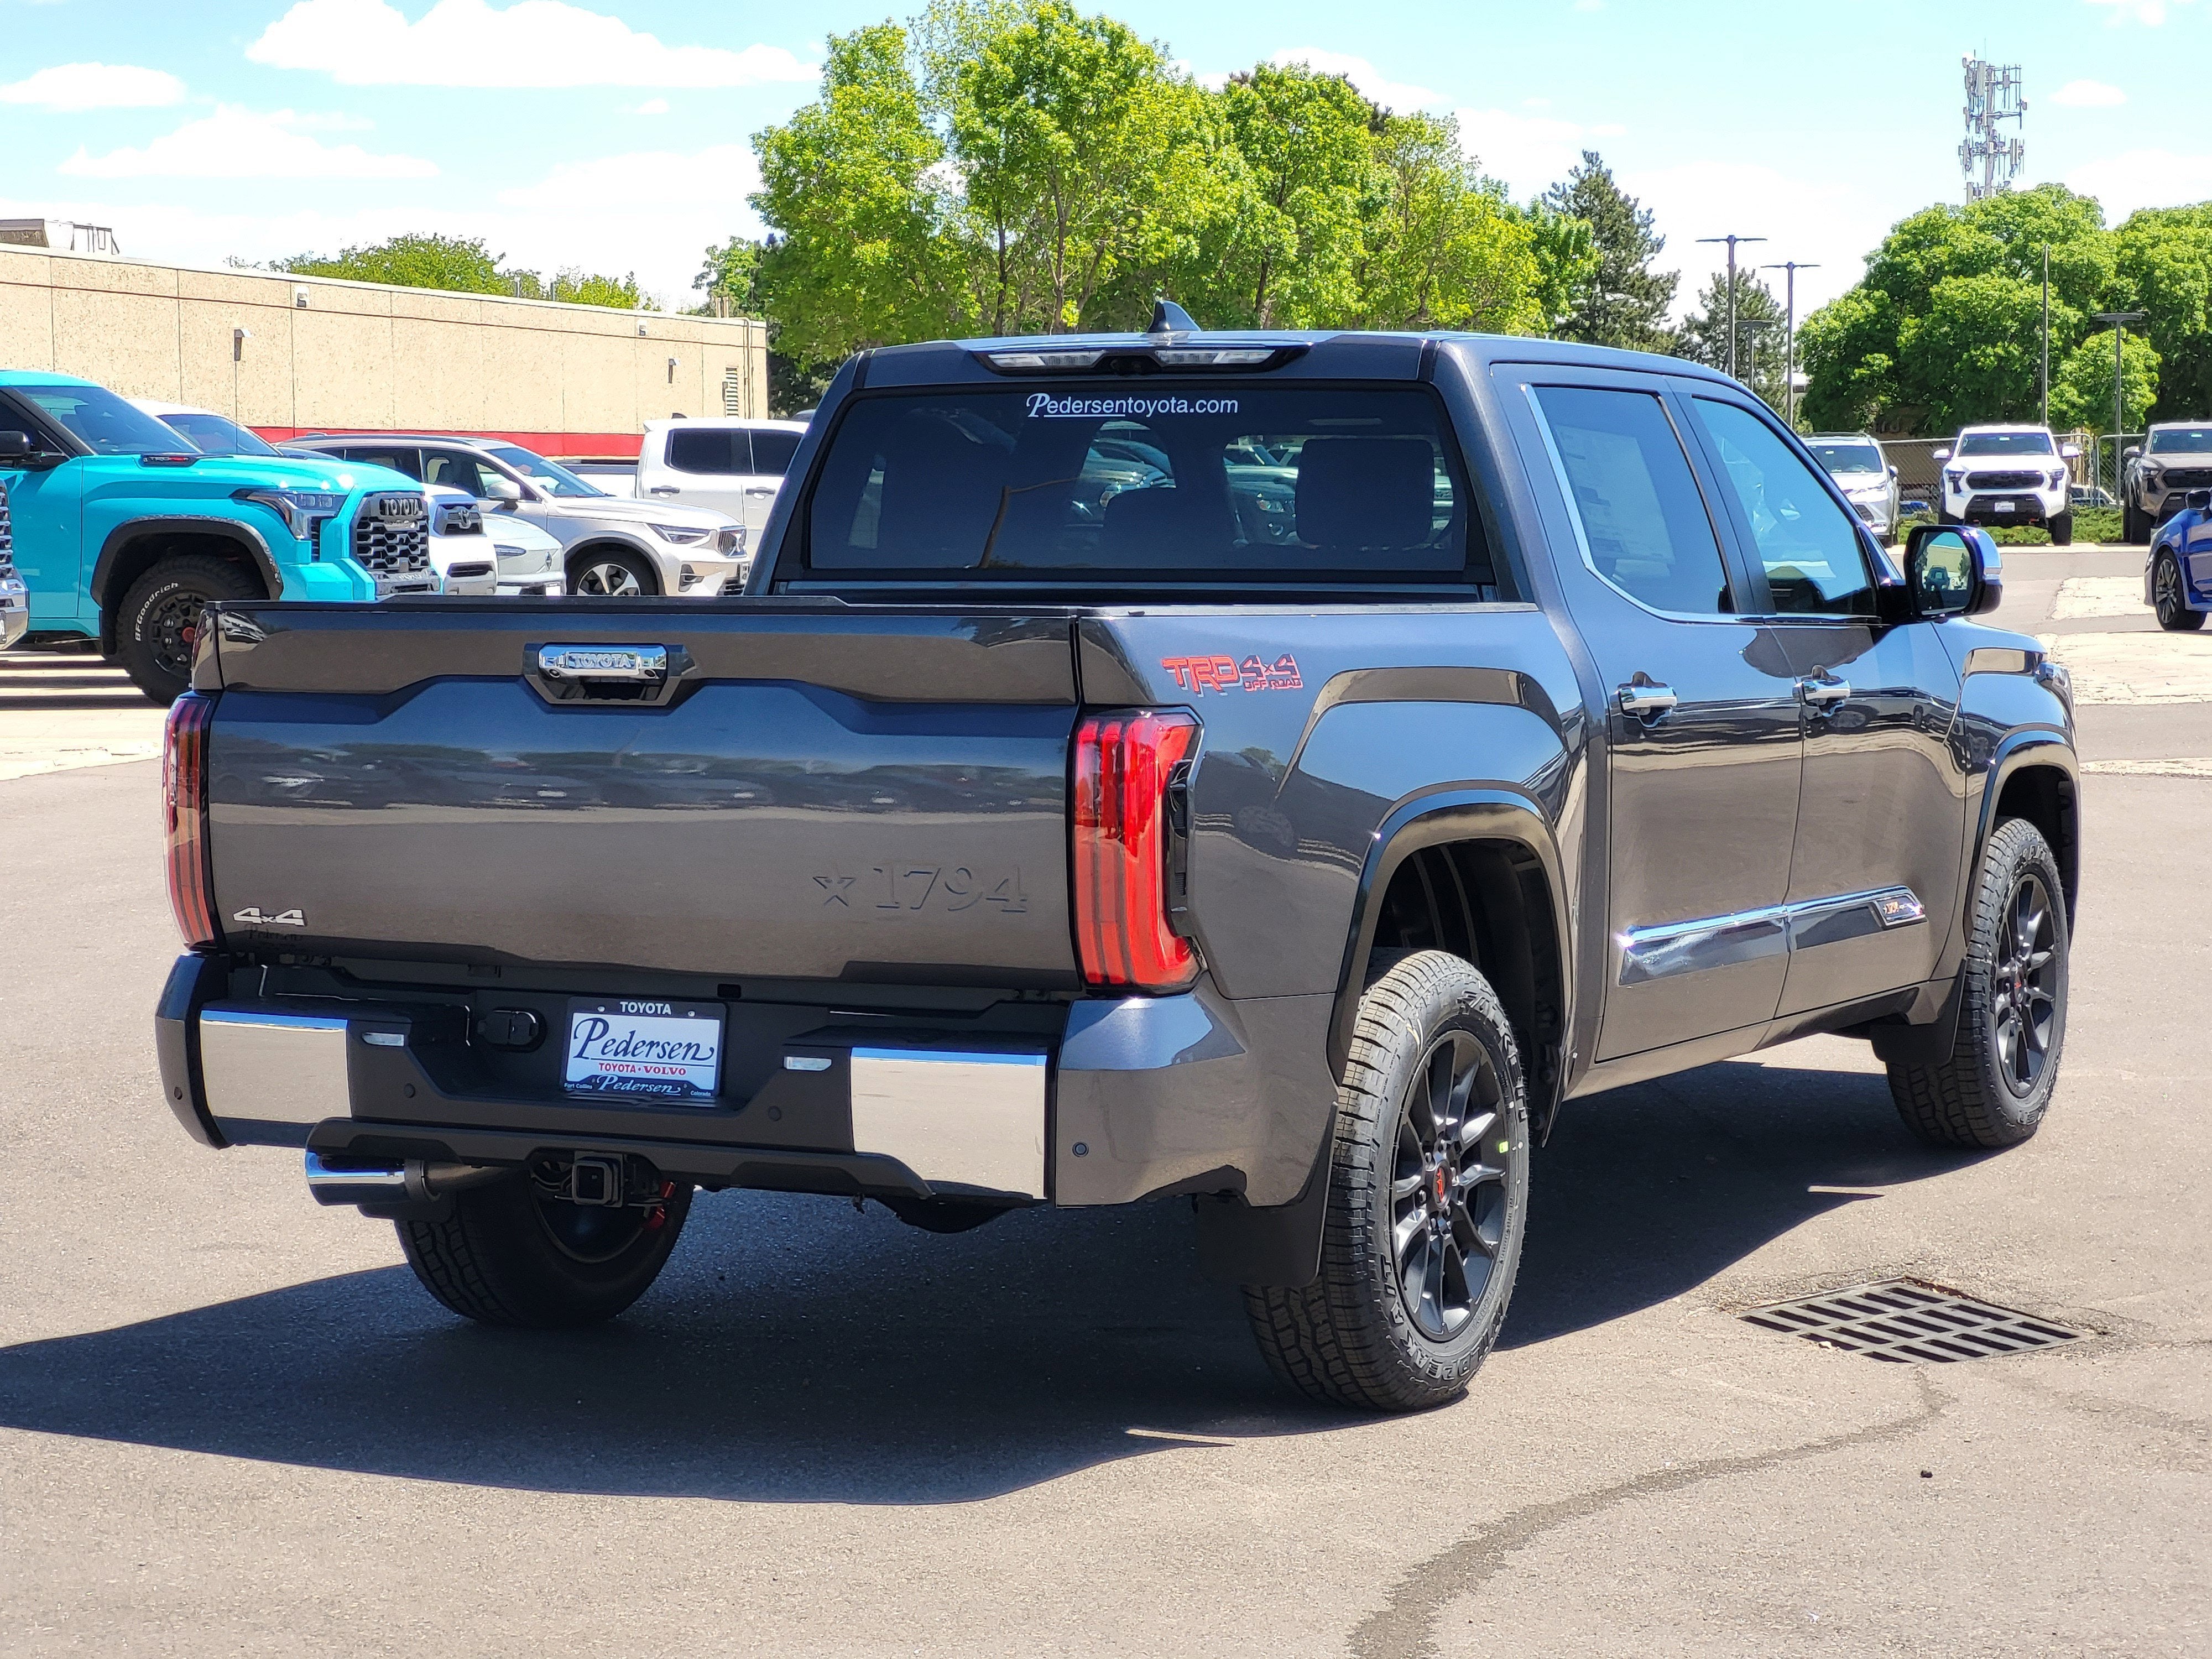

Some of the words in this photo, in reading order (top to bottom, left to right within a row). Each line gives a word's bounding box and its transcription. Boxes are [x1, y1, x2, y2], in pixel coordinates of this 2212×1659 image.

[1026, 392, 1239, 418] Pedersentoyota.com
[384, 498, 423, 517] TOYOTA
[134, 582, 179, 641] BFGoodrich
[571, 653, 632, 669] TOYOTA
[1162, 655, 1240, 695] TRD
[1239, 653, 1301, 680] 4x4
[1244, 680, 1268, 692] OFF
[1269, 678, 1303, 689] ROAD
[873, 867, 1028, 913] 1794
[233, 907, 305, 927] 4x4
[619, 1001, 672, 1015] TOYOTA
[573, 1017, 715, 1061] Pedersen
[598, 1062, 636, 1073] TOYOTA
[643, 1065, 687, 1076] VOLVO
[596, 1074, 681, 1096] Pedersen
